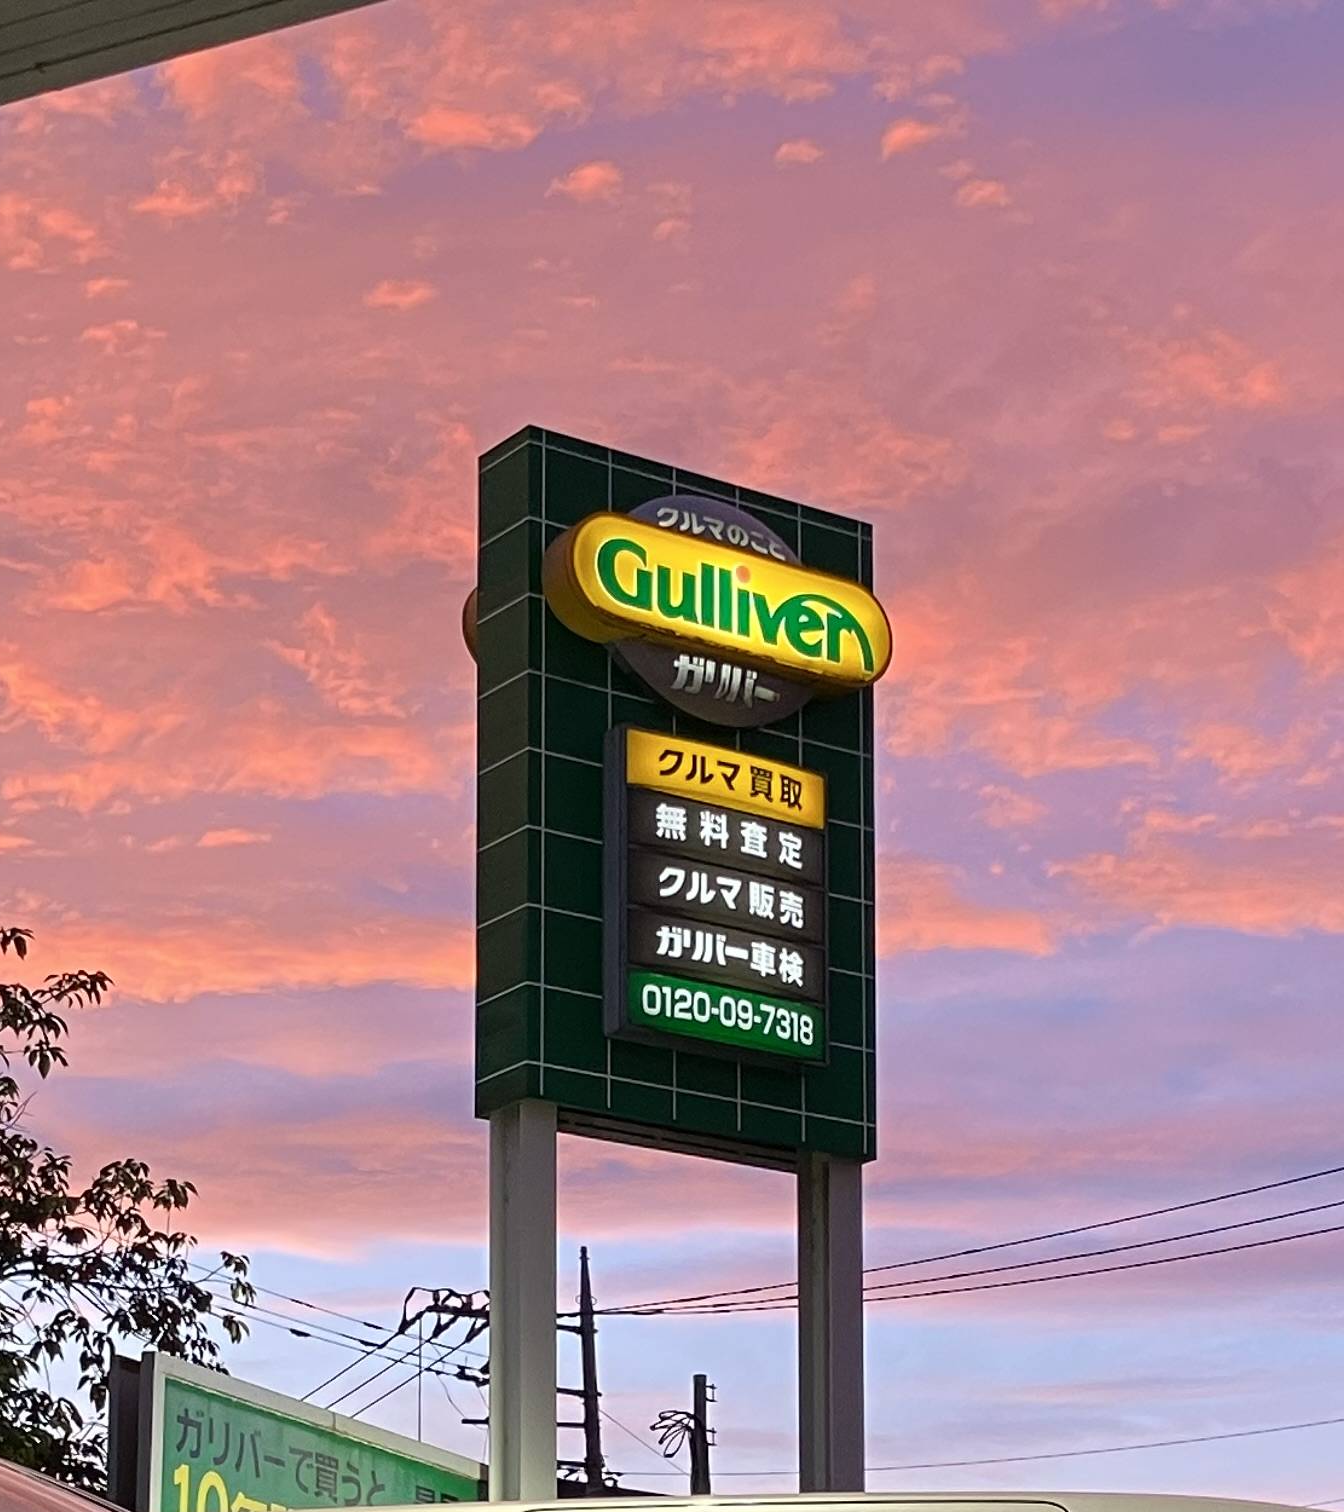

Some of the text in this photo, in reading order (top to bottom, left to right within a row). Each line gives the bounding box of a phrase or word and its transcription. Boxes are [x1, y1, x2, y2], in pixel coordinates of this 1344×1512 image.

[596, 538, 874, 672] Gulliver
[670, 654, 781, 707] ガリバー
[658, 749, 803, 812] クルマ買取
[655, 802, 804, 870] 無料査定
[658, 866, 805, 929] クルマ販売
[655, 924, 804, 988] ガリバー車検
[641, 983, 814, 1046] 0120-09-7318
[176, 1407, 386, 1507] ガリバーで買うと
